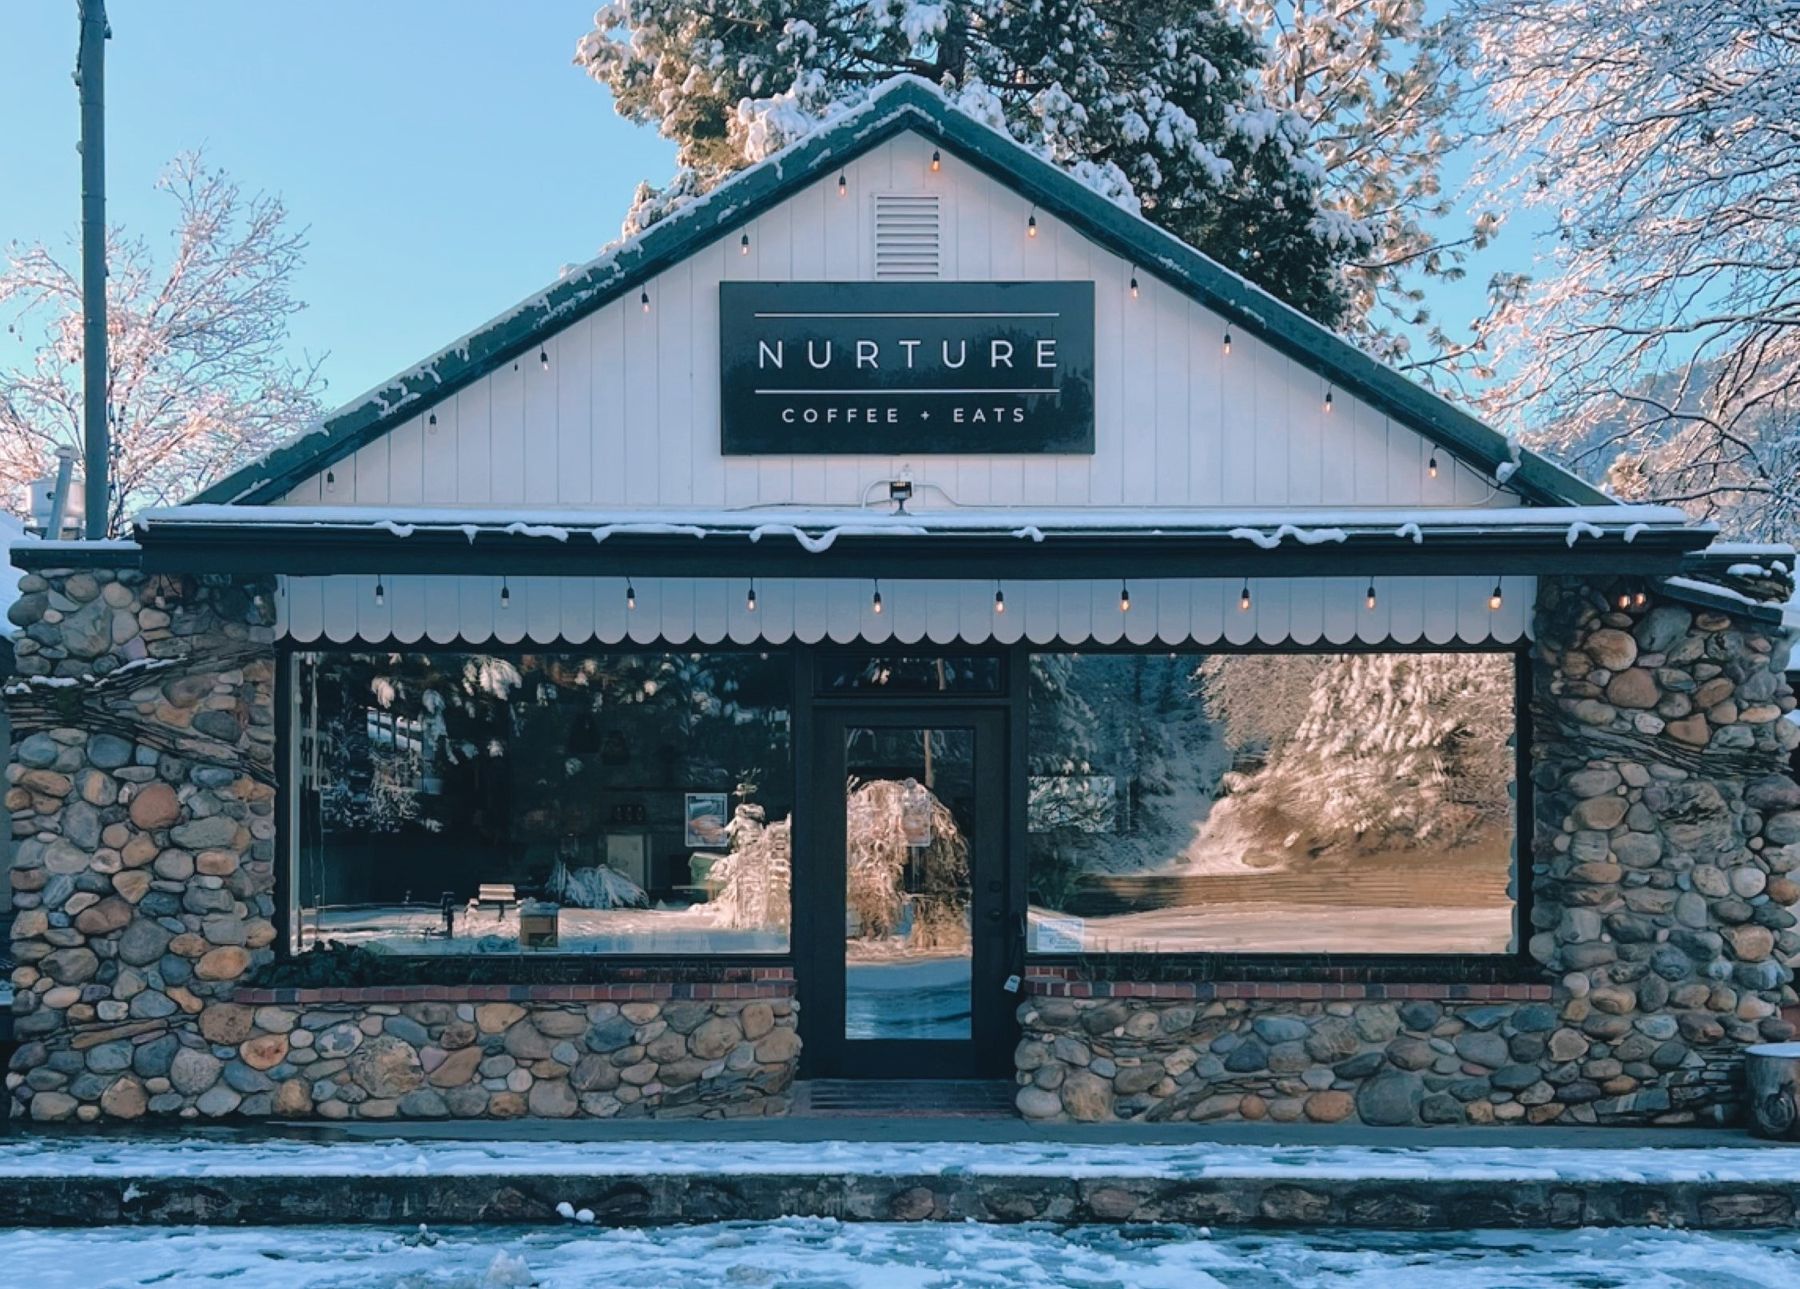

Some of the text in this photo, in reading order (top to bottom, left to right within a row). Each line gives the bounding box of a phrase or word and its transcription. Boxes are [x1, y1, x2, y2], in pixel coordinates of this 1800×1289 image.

[758, 339, 1058, 369] NURTURE
[781, 408, 899, 423] COFFEE
[953, 407, 1025, 423] EATS
